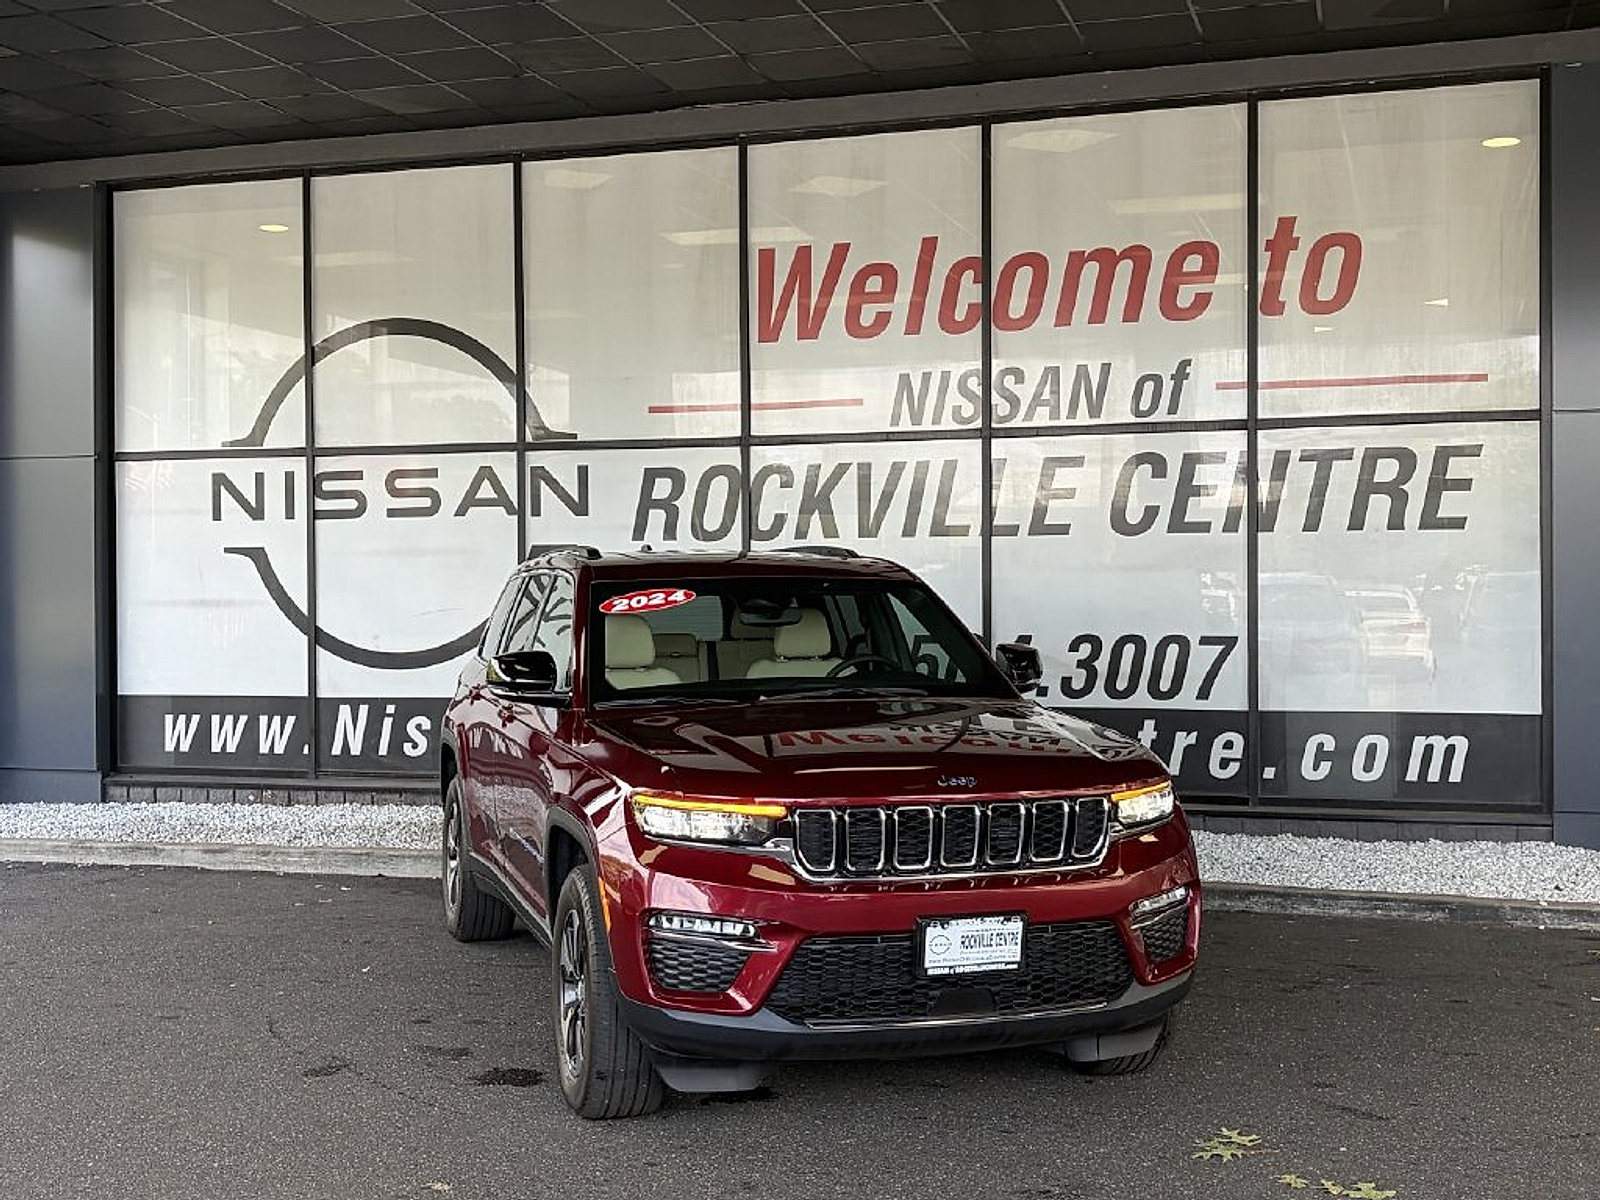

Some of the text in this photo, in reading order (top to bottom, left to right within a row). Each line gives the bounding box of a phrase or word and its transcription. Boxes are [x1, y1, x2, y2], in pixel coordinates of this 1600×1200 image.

[757, 216, 1363, 344] Welcome to
[890, 358, 1193, 427] NISSAN of
[212, 464, 589, 521] NISSAN
[631, 443, 1485, 542] ROCKVILLE CENTRE
[611, 589, 685, 613] 2024
[937, 775, 976, 788] Jeep
